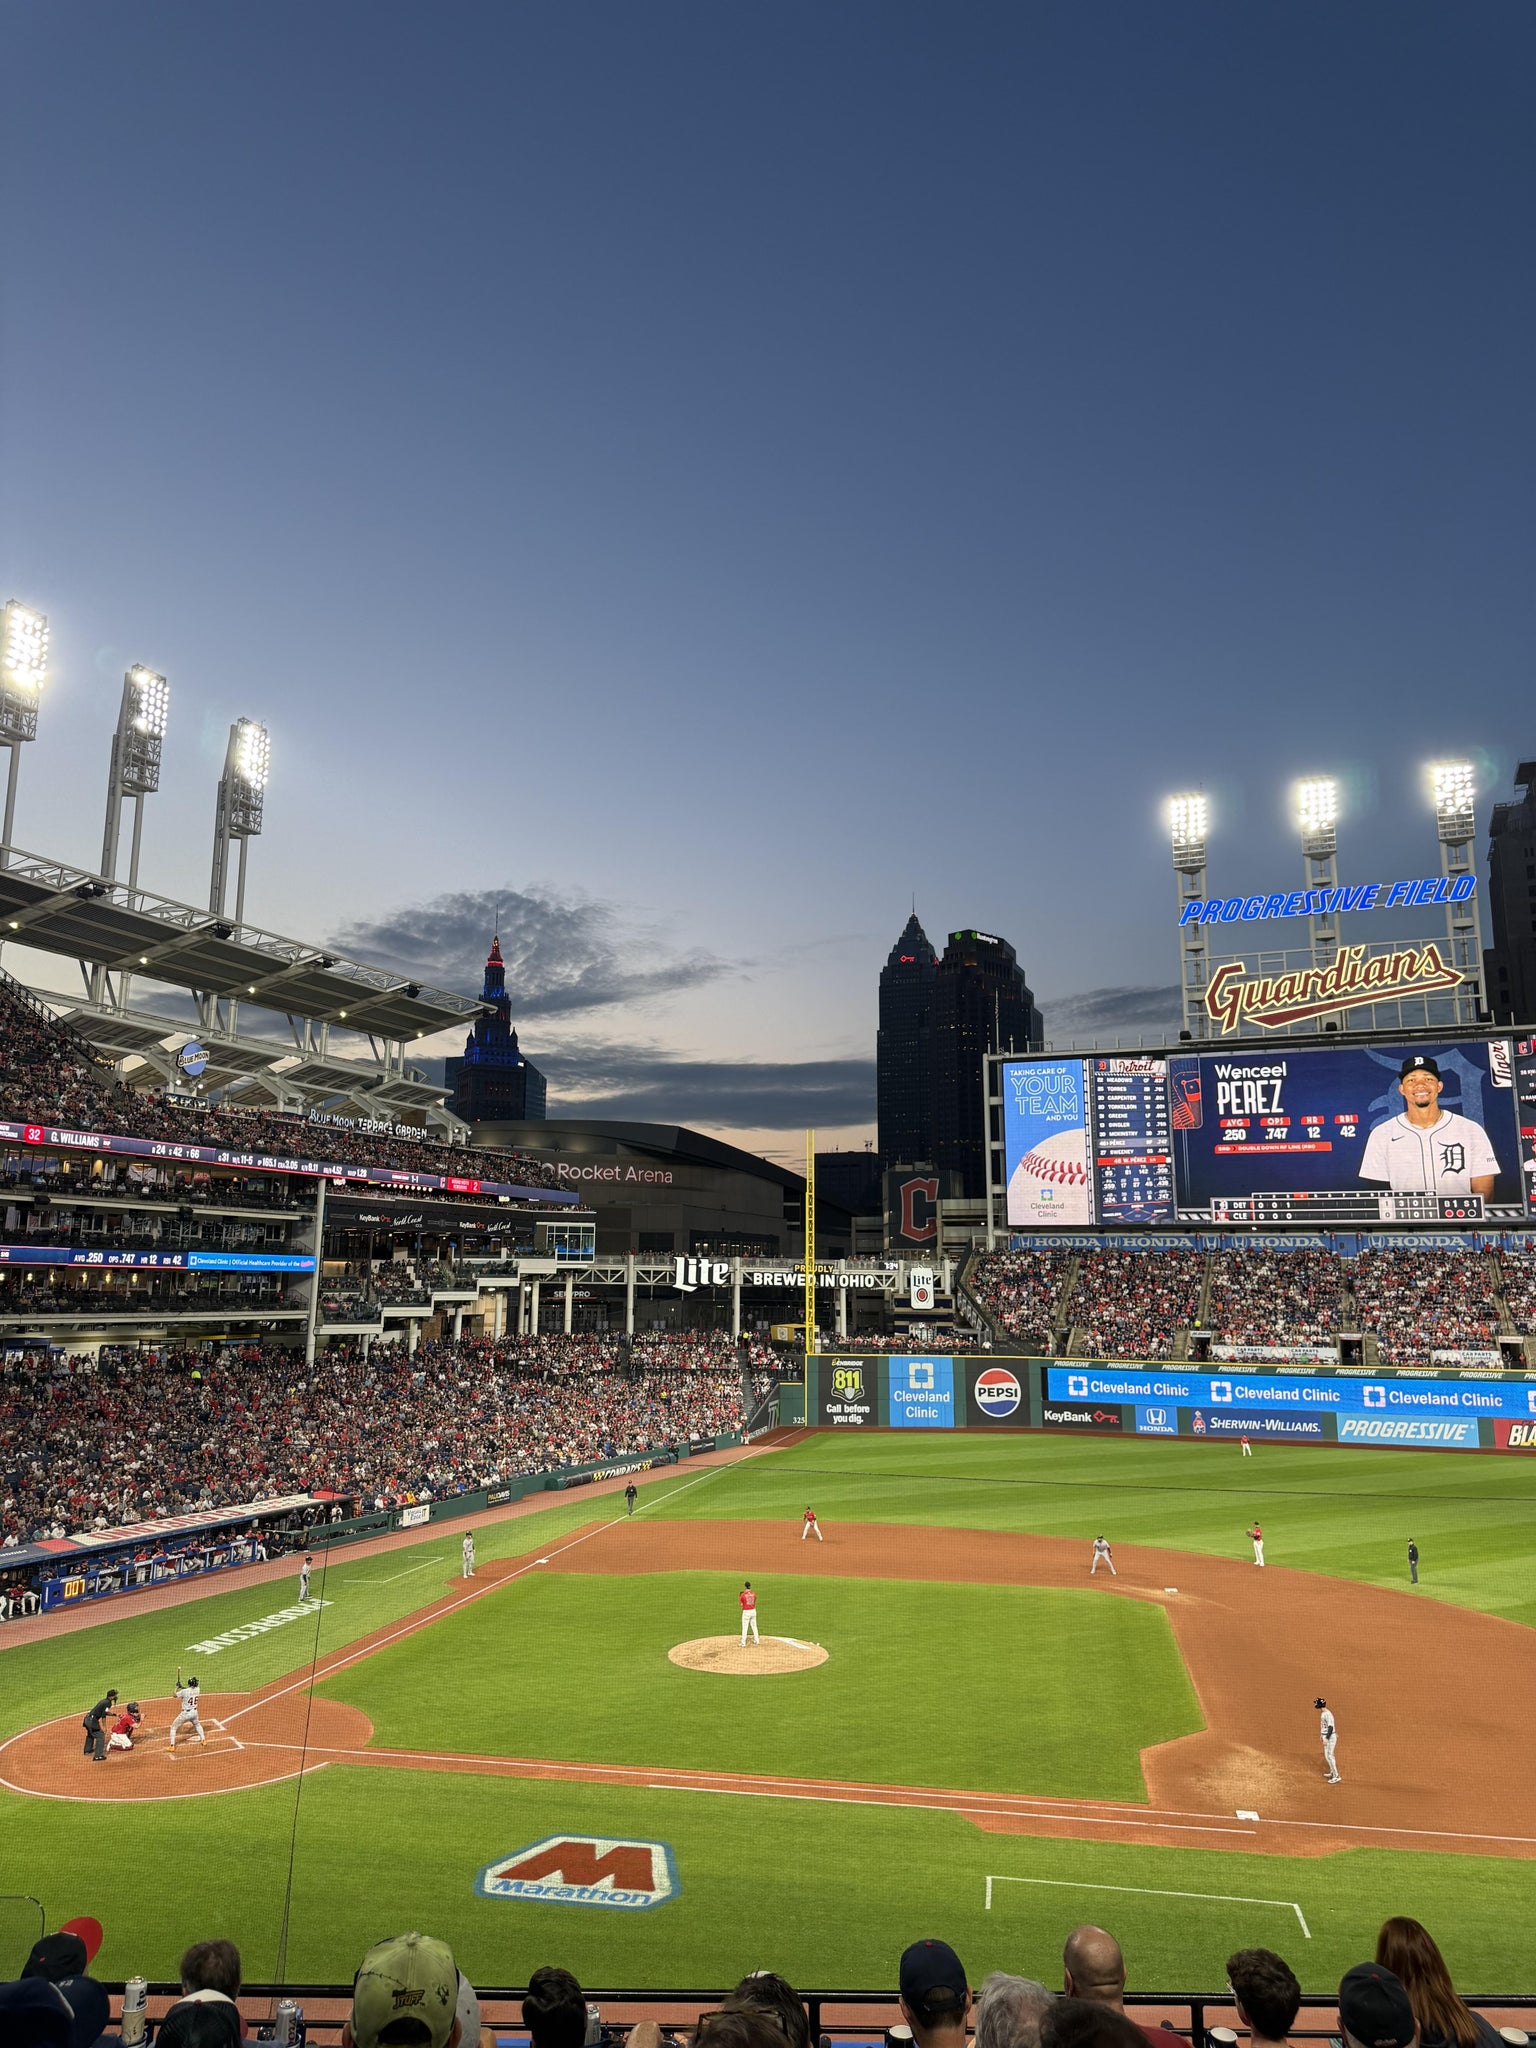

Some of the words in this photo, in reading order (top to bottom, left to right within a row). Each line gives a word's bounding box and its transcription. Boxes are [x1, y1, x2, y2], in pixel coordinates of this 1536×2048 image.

[1178, 883, 1383, 927] PROGRESSIVE
[1385, 874, 1477, 907] FIELD
[1205, 943, 1463, 1035] Guardians
[179, 1055, 193, 1065] BLUE
[194, 1052, 209, 1060] MOON
[1118, 1060, 1156, 1073] Detroit
[1214, 1061, 1287, 1079] Wenceel
[1010, 1075, 1076, 1095] YOUR
[1014, 1095, 1078, 1115] TEAM
[309, 1109, 330, 1124] BLUE
[332, 1115, 355, 1128] MOON
[358, 1118, 393, 1134] TERRACE
[395, 1124, 427, 1139] GARDEN
[1306, 1116, 1318, 1124] HR
[1339, 1115, 1353, 1123] RBI
[1222, 1129, 1246, 1141] .250
[1265, 1128, 1288, 1140] .747
[1307, 1127, 1321, 1139] 12
[1340, 1125, 1356, 1138] 42
[28, 1128, 40, 1140] 32
[51, 1132, 59, 1143] G.
[60, 1132, 100, 1147] WILLIAMS
[156, 1145, 166, 1155] 24
[173, 1147, 182, 1157] 42
[221, 1152, 229, 1162] 31
[240, 1154, 253, 1165] 11-5
[262, 1157, 277, 1168] 165.1
[284, 1160, 298, 1170] 3.05
[331, 1165, 343, 1175] 4.52
[1438, 1141, 1466, 1178] D
[558, 1163, 621, 1181] Rocket
[625, 1166, 673, 1184] Arena
[473, 1182, 478, 1191] 2
[900, 1177, 939, 1242] C
[1030, 1202, 1065, 1210] Cleveland
[1452, 1200, 1458, 1208] 1
[359, 1214, 380, 1222] KeyBank
[1233, 1212, 1248, 1220] CLE
[459, 1221, 477, 1229] KeyBank
[1034, 1238, 1101, 1247] HONDA
[1122, 1238, 1194, 1247] HONDA
[1250, 1237, 1325, 1247] HONDA
[1387, 1236, 1467, 1247] HONDA
[86, 1253, 103, 1263] .250
[119, 1254, 135, 1264] .747
[149, 1255, 157, 1264] 12
[172, 1255, 182, 1265] 42
[672, 1256, 729, 1293] Lite
[794, 1264, 834, 1273] PRUDLY
[821, 1274, 835, 1287] IN
[839, 1275, 875, 1288] OHIO
[913, 1275, 932, 1287] Lite
[553, 1290, 591, 1298] SEPRO
[1054, 1360, 1091, 1368] PROGRESSIVE
[1106, 1362, 1145, 1370] PROGRESSIVE
[1161, 1364, 1201, 1372] PROGRESSIVE
[1218, 1365, 1259, 1374] PROGRESSIVE
[1275, 1367, 1316, 1375] PROGRESSIVE
[1335, 1368, 1377, 1376] PROGRESSIVE
[1396, 1370, 1439, 1378] PROGRESSIVE
[1459, 1371, 1504, 1379] PROGRESSIVE
[835, 1370, 860, 1390] 811
[978, 1386, 1018, 1398] PEPSI
[1090, 1380, 1151, 1395] Cleveland
[1153, 1383, 1189, 1397] Clinic
[1234, 1386, 1299, 1401] Cleveland
[1302, 1388, 1341, 1402] Clinic
[894, 1390, 951, 1403] Cleveland
[1389, 1390, 1459, 1406] Cleveland
[1461, 1393, 1503, 1407] Clinic
[826, 1403, 842, 1413] Call
[844, 1403, 870, 1413] before
[905, 1406, 939, 1419] Clinic
[833, 1415, 848, 1425] you
[848, 1413, 864, 1425] dig.
[1044, 1410, 1092, 1423] KeyBank
[1139, 1425, 1174, 1433] HONDA
[1340, 1419, 1466, 1441] PROGRESSIVE
[87, 1507, 246, 1542] CLEVELAND
[64, 1579, 86, 1599] 007
[184, 1597, 335, 1655] PROGRESSIVE
[492, 1880, 652, 1905] Marathon
